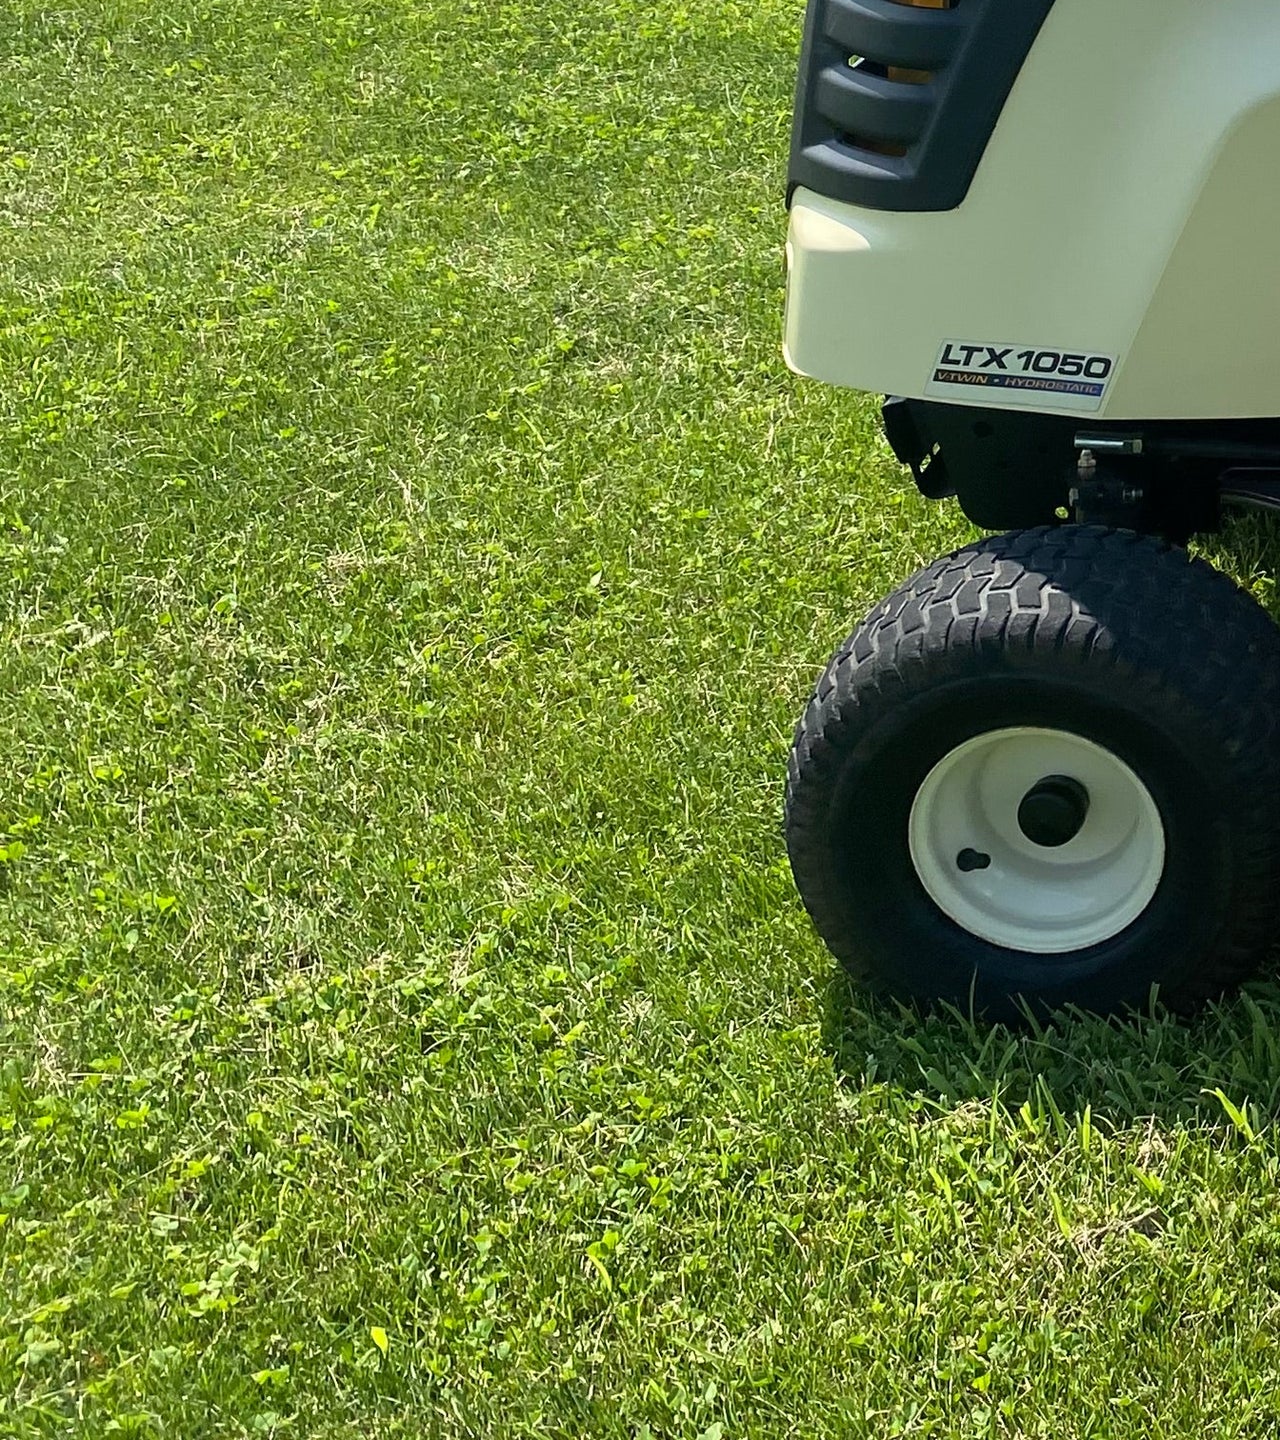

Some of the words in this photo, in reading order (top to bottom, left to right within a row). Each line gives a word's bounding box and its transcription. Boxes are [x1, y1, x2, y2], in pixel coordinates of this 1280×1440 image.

[940, 344, 1015, 370] LTX
[1016, 350, 1112, 379] 1050
[937, 371, 989, 385] V-TWIN
[1004, 377, 1100, 394] HYDROSTATIC
